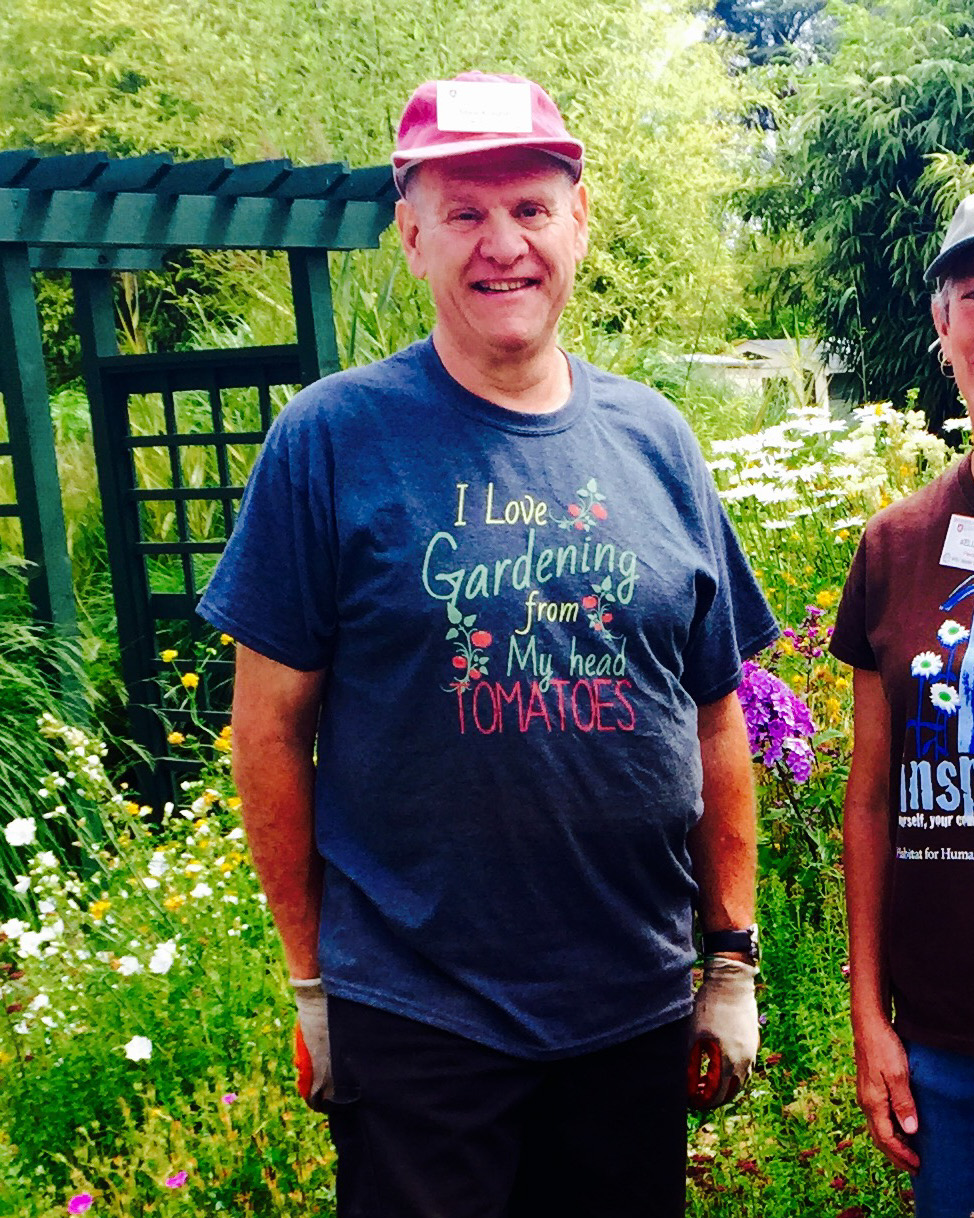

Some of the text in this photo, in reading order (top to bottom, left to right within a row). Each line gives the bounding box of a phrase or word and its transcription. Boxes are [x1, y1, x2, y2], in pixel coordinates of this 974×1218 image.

[454, 482, 548, 526] I Love
[422, 528, 641, 606] Gardening
[514, 590, 580, 635] from
[506, 635, 627, 692] My head
[450, 678, 636, 734] TOMATOES
[930, 814, 954, 829] your
[924, 847, 939, 859] for
